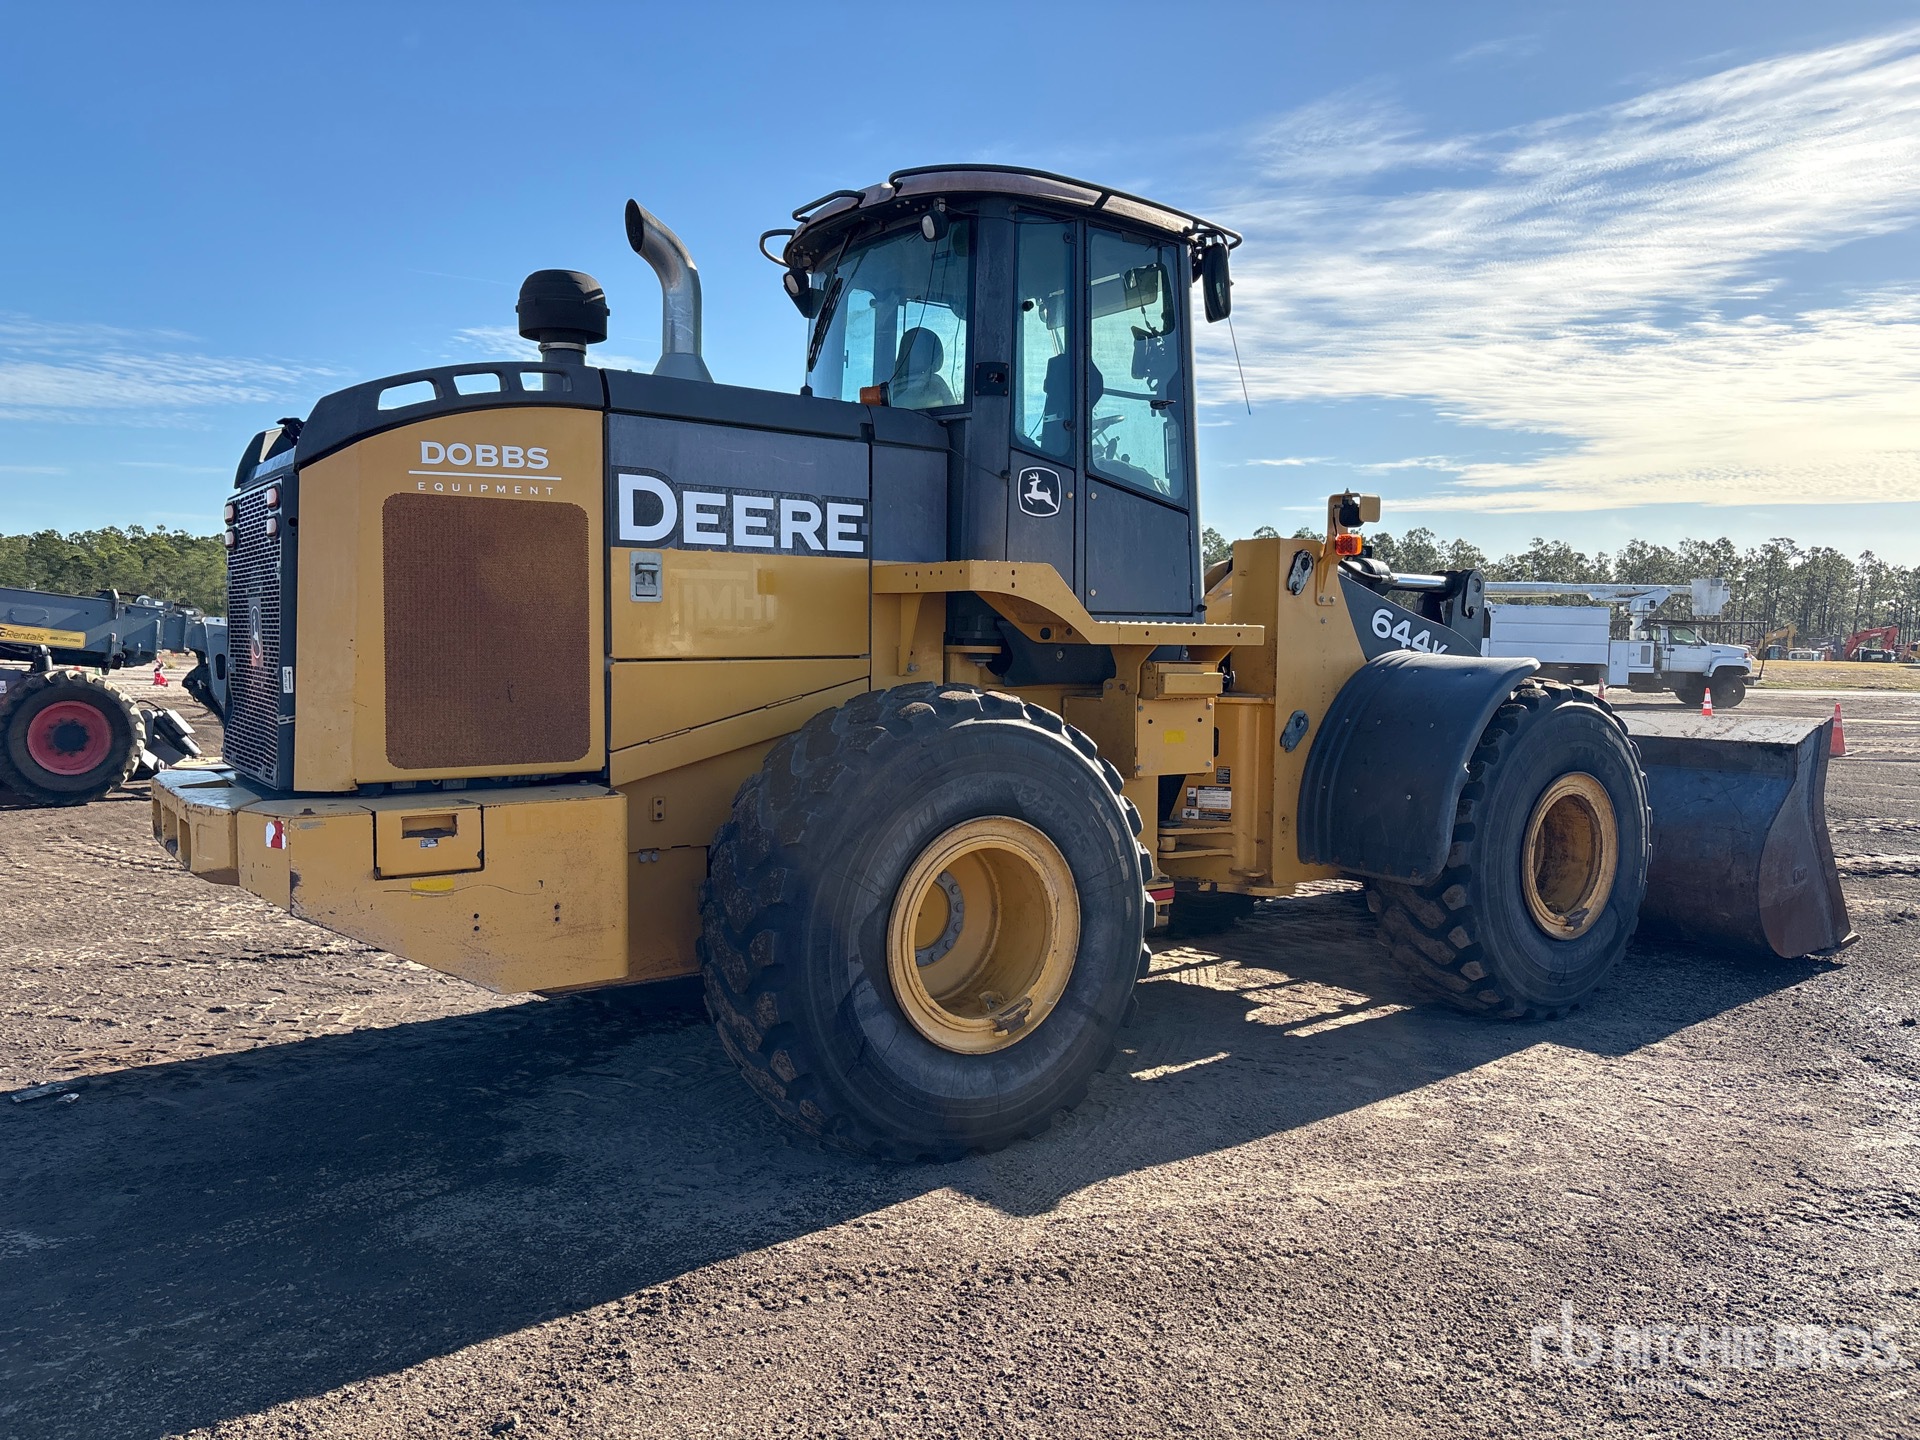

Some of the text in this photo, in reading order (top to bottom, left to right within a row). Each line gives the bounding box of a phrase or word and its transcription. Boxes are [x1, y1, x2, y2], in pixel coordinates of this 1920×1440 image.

[420, 440, 550, 470] DOBBS
[417, 481, 554, 496] EQUIPMENT
[617, 472, 865, 554] DEERE
